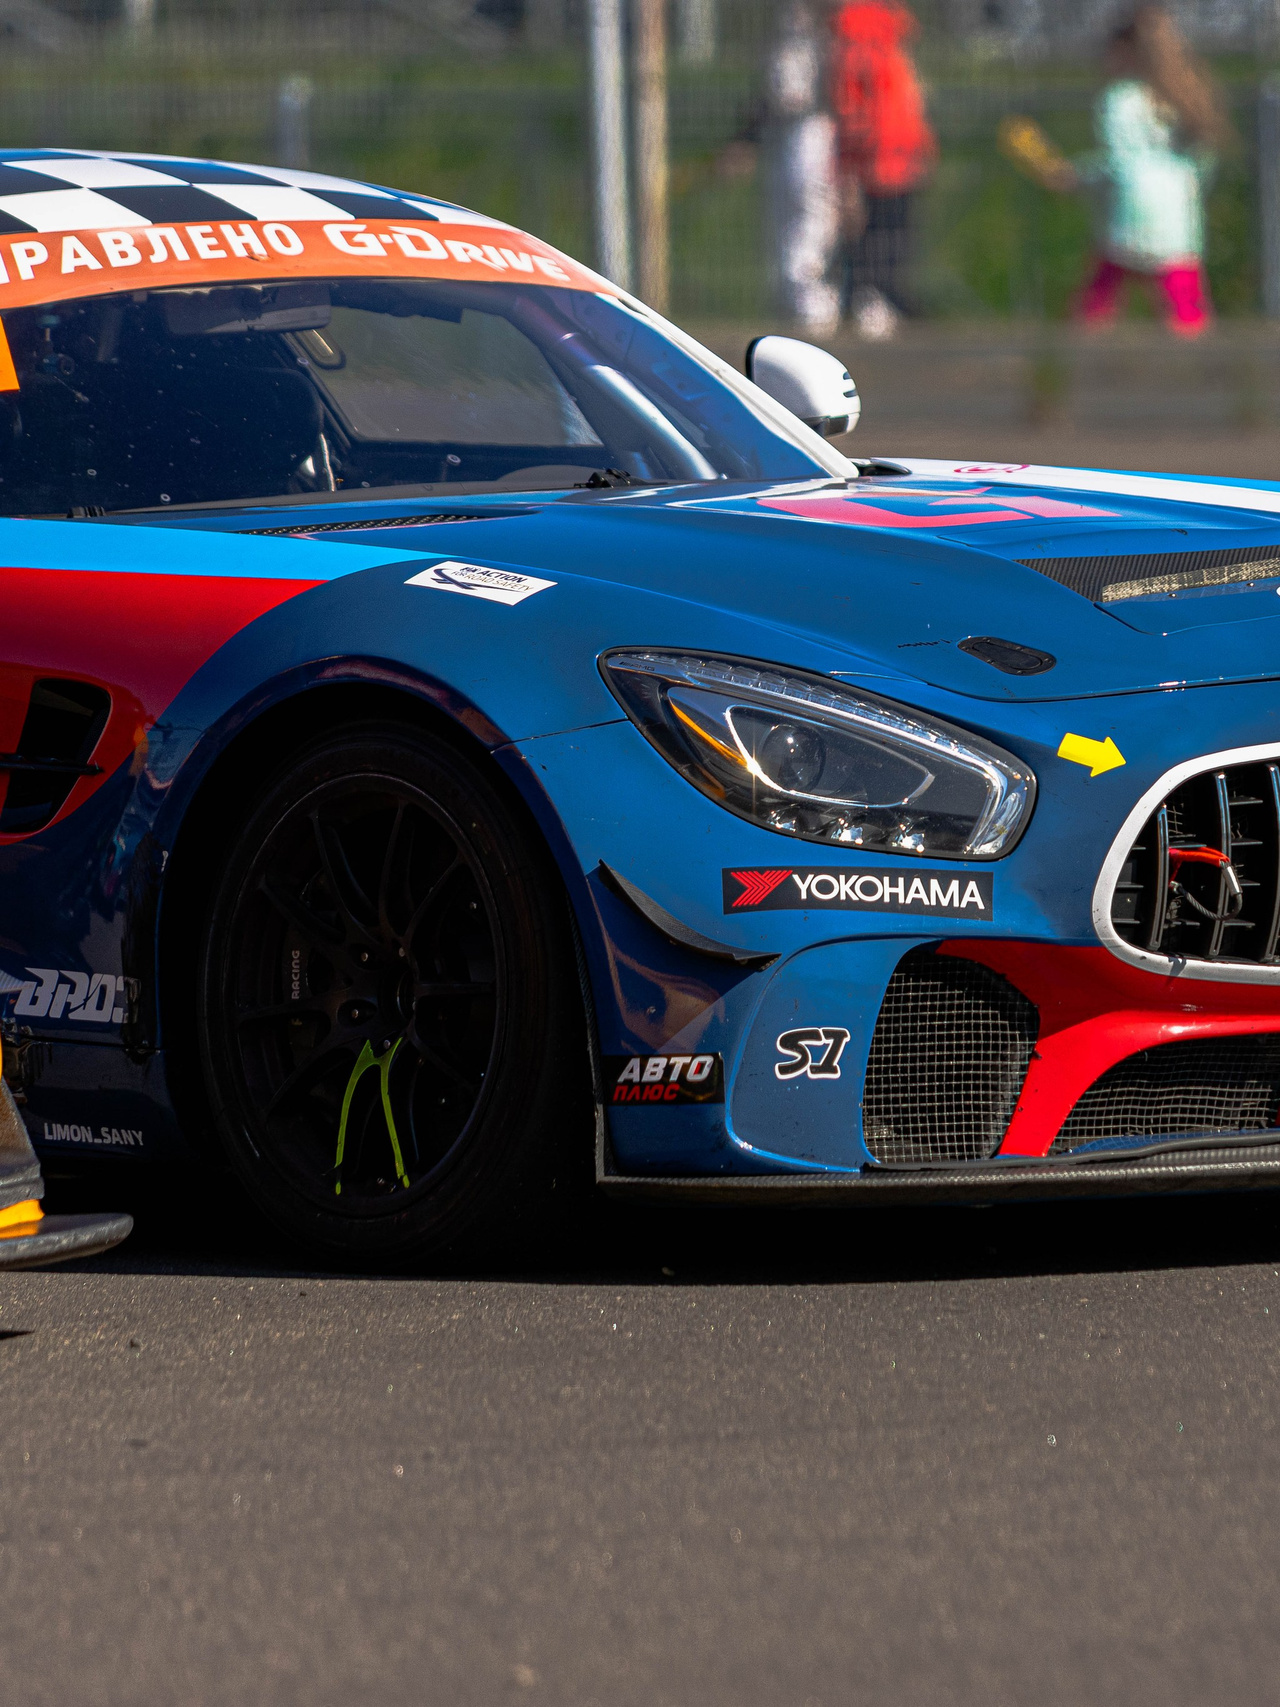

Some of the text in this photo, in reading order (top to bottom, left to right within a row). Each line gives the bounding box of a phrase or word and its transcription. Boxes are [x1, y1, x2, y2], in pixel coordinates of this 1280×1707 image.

[0, 222, 305, 284] РАВЛЕНО
[464, 573, 494, 583] ROAD
[493, 579, 534, 591] SAFETY
[476, 570, 528, 583] ACTION
[791, 873, 986, 910] YOKOHAMA
[291, 949, 300, 1000] RACING
[43, 1122, 144, 1146] LIMON_SANY
